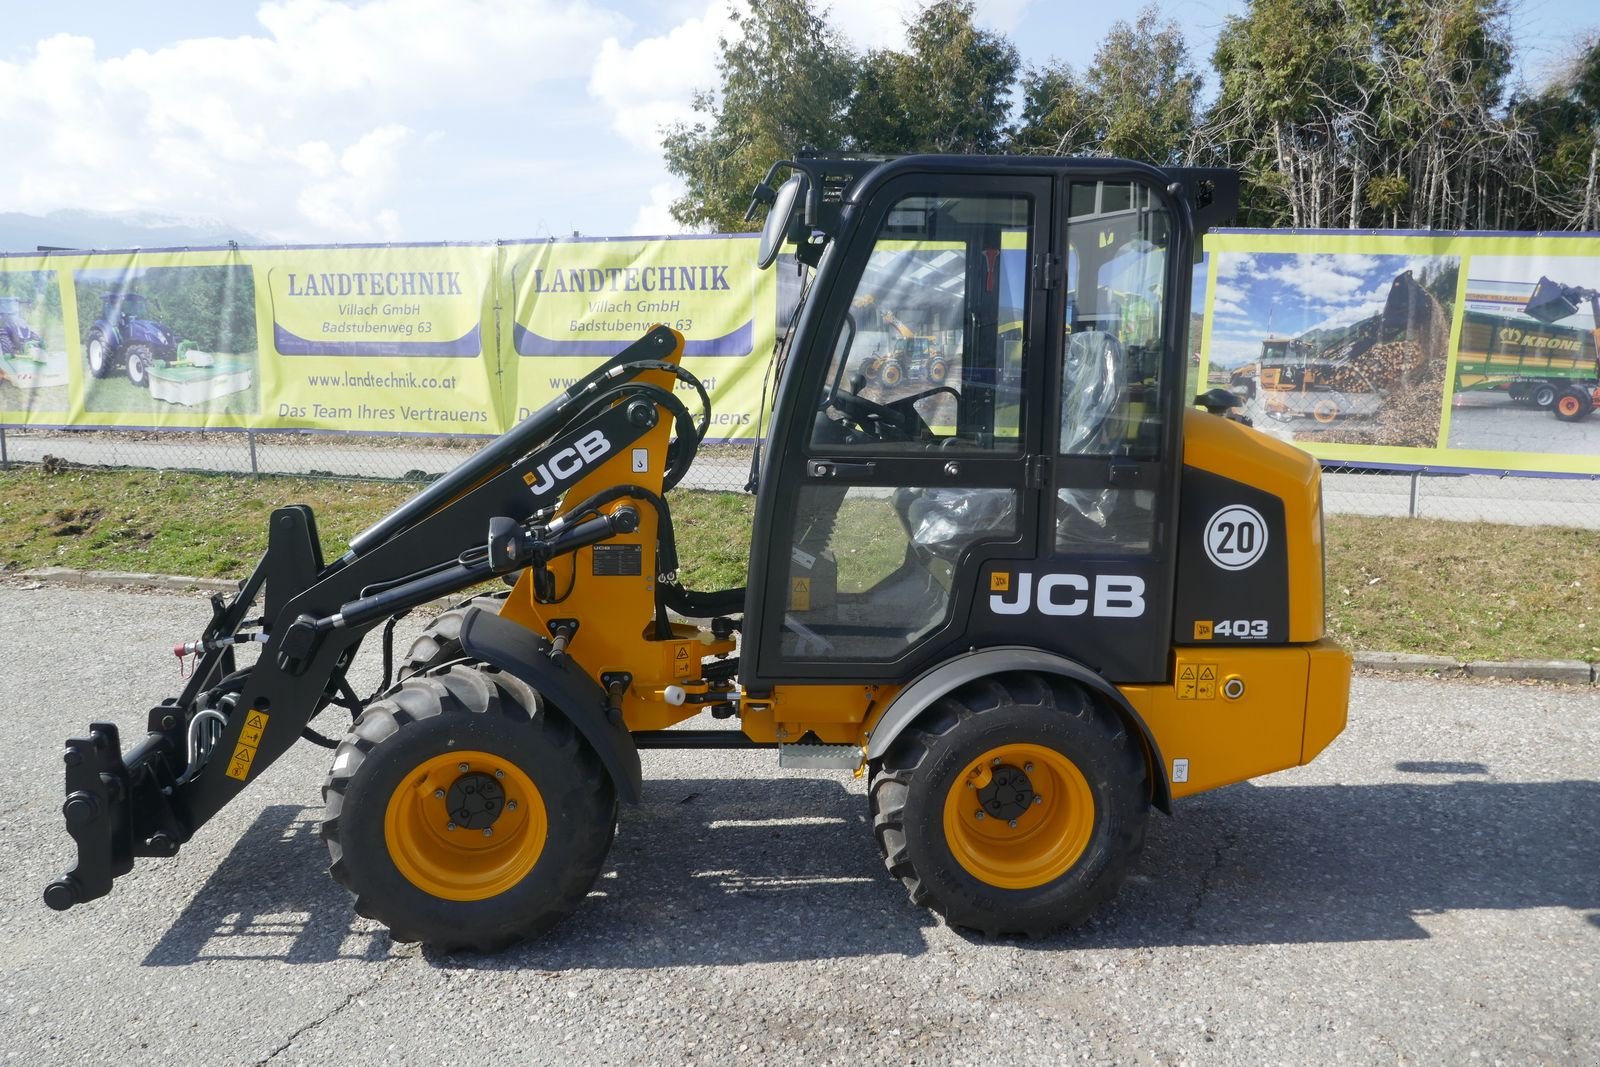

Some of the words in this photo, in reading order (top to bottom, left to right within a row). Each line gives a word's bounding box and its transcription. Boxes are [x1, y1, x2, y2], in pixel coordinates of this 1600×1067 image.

[288, 271, 462, 296] LANDTECHNIK
[534, 265, 730, 293] LANDTECHNIK
[338, 304, 378, 316] Villach
[382, 304, 420, 315] GmbH
[588, 300, 631, 313] Villach
[636, 300, 680, 312] GmbH
[321, 321, 413, 336] Badstubenweg
[417, 321, 432, 333] 63
[569, 319, 671, 332] Badstubenw
[676, 319, 692, 331] 63
[1521, 335, 1583, 351] KRONE
[308, 371, 456, 389] www.landtechnik.co.at
[278, 403, 306, 418] Das
[312, 404, 352, 418] Team
[358, 404, 395, 420] Ihres
[400, 406, 488, 422] Vertrauens
[530, 429, 611, 495] JCB
[1217, 521, 1254, 554] 20
[990, 573, 1145, 618] JCB
[1214, 620, 1268, 636] 403
